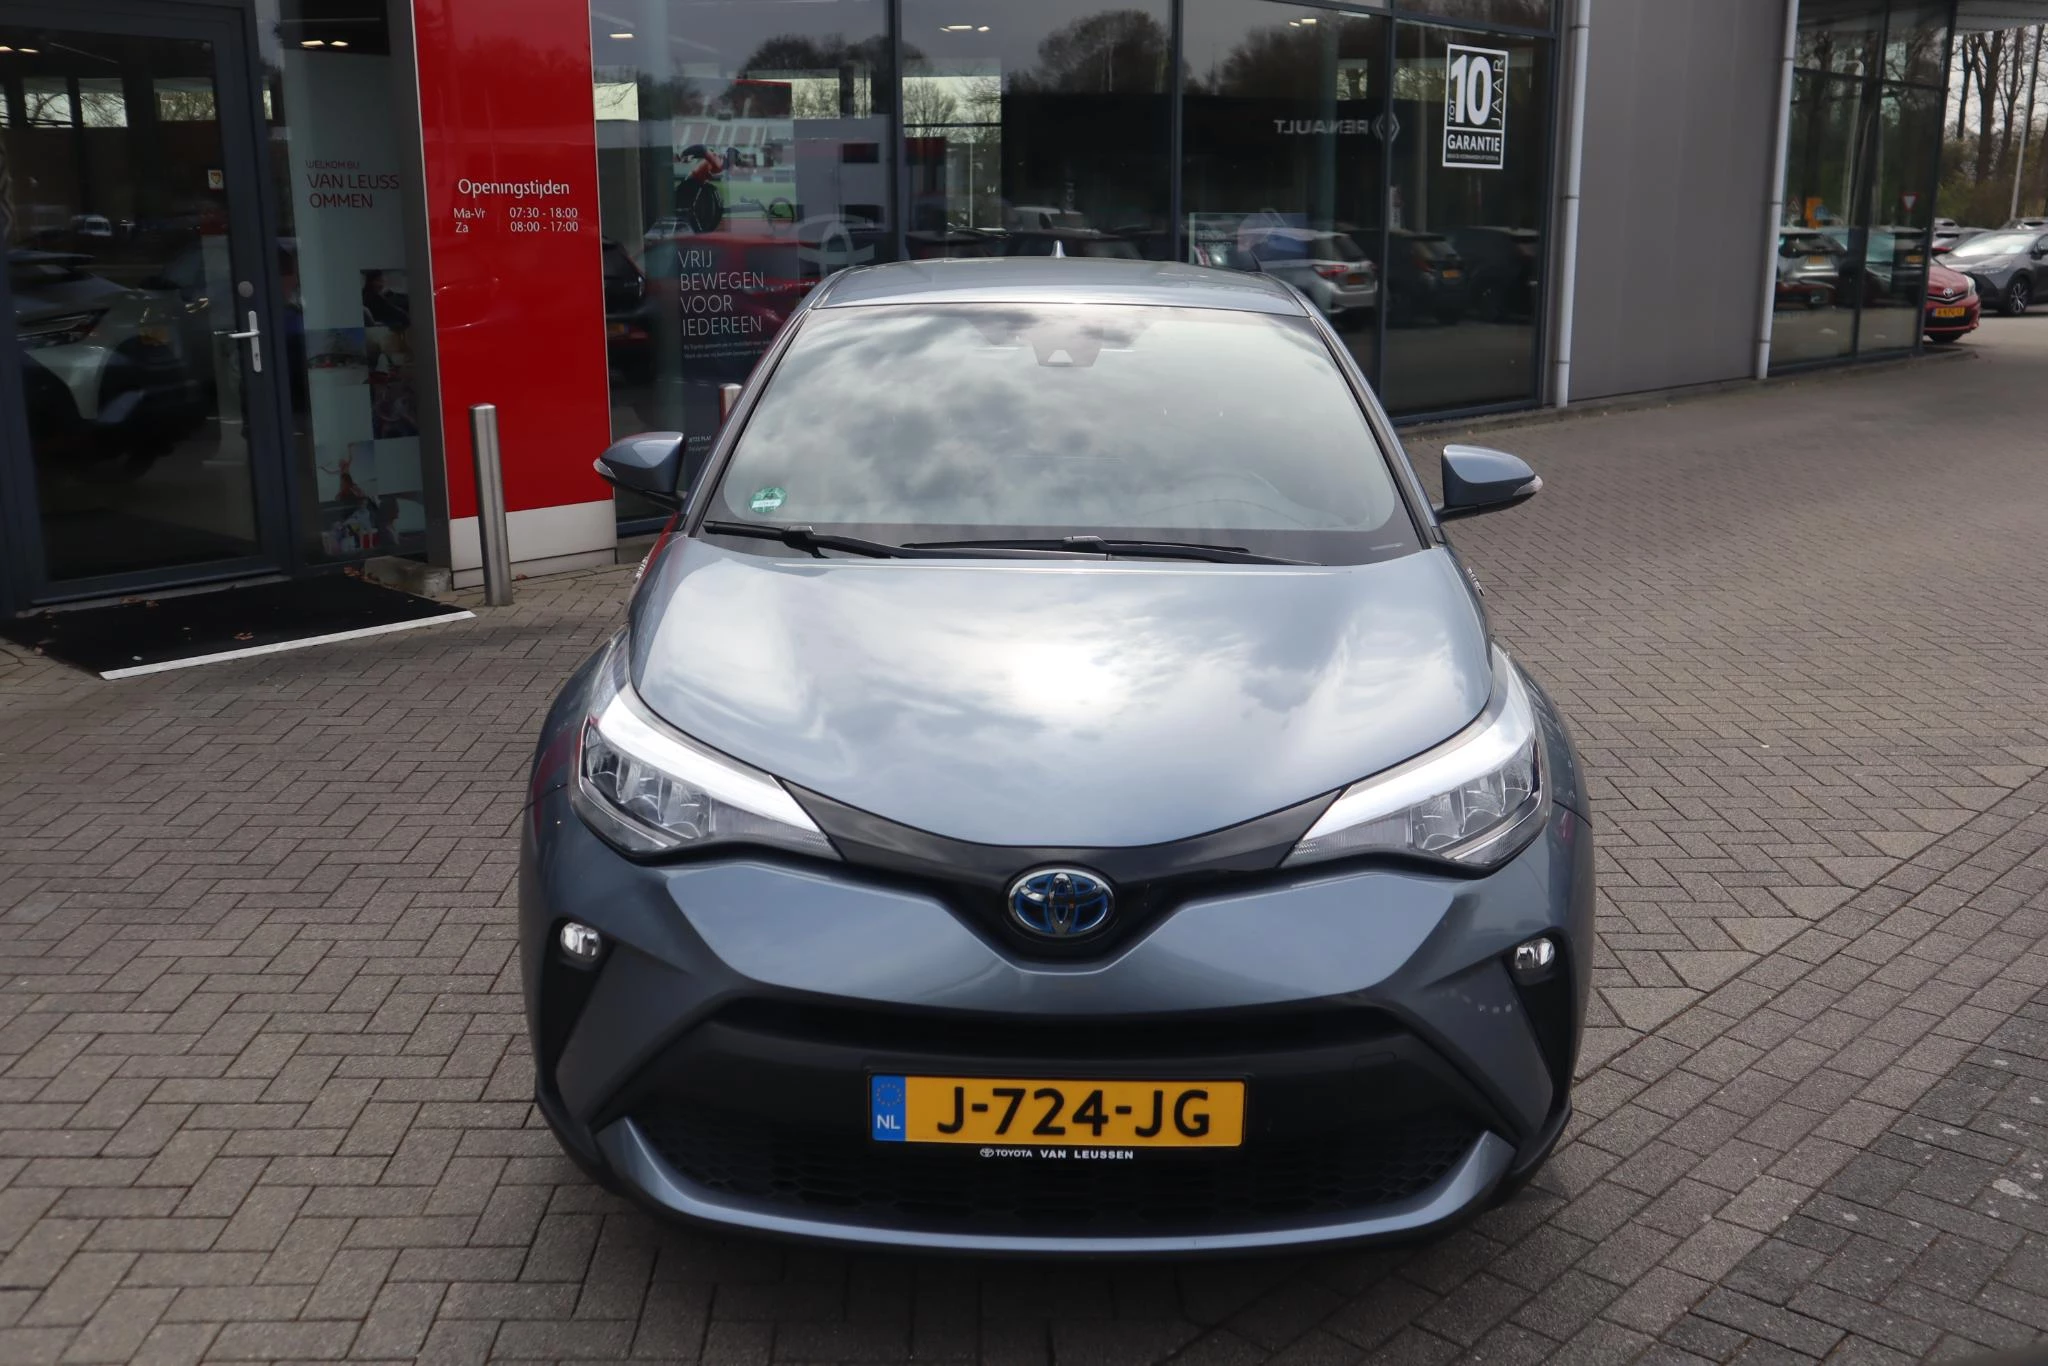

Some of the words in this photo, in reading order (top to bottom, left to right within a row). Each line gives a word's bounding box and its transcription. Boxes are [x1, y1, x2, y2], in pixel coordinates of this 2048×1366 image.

[1450, 54, 1492, 126] 10
[1491, 59, 1505, 126] JAAR
[1447, 134, 1500, 152] GARANTIE
[307, 174, 343, 189] VAN
[348, 174, 400, 189] LEUSS
[458, 178, 570, 199] Openingstijden
[309, 193, 373, 208] OMMEN
[453, 208, 485, 219] Ma-Vr
[509, 207, 539, 219] 07:30
[550, 207, 578, 218] 18:00
[455, 222, 469, 233] Za
[510, 221, 540, 232] 08:00
[551, 221, 579, 232] 17:00
[678, 249, 712, 269] VRIJ
[680, 271, 764, 291] BEWEGEN
[680, 294, 733, 313] VOOR
[682, 315, 762, 336] IEDEREEN
[877, 1114, 901, 1130] NL
[937, 1086, 1210, 1138] J-724-JG
[995, 1148, 1032, 1158] TOYOTA
[1040, 1149, 1066, 1159] VAN
[1074, 1149, 1134, 1159] LEUSSEN
